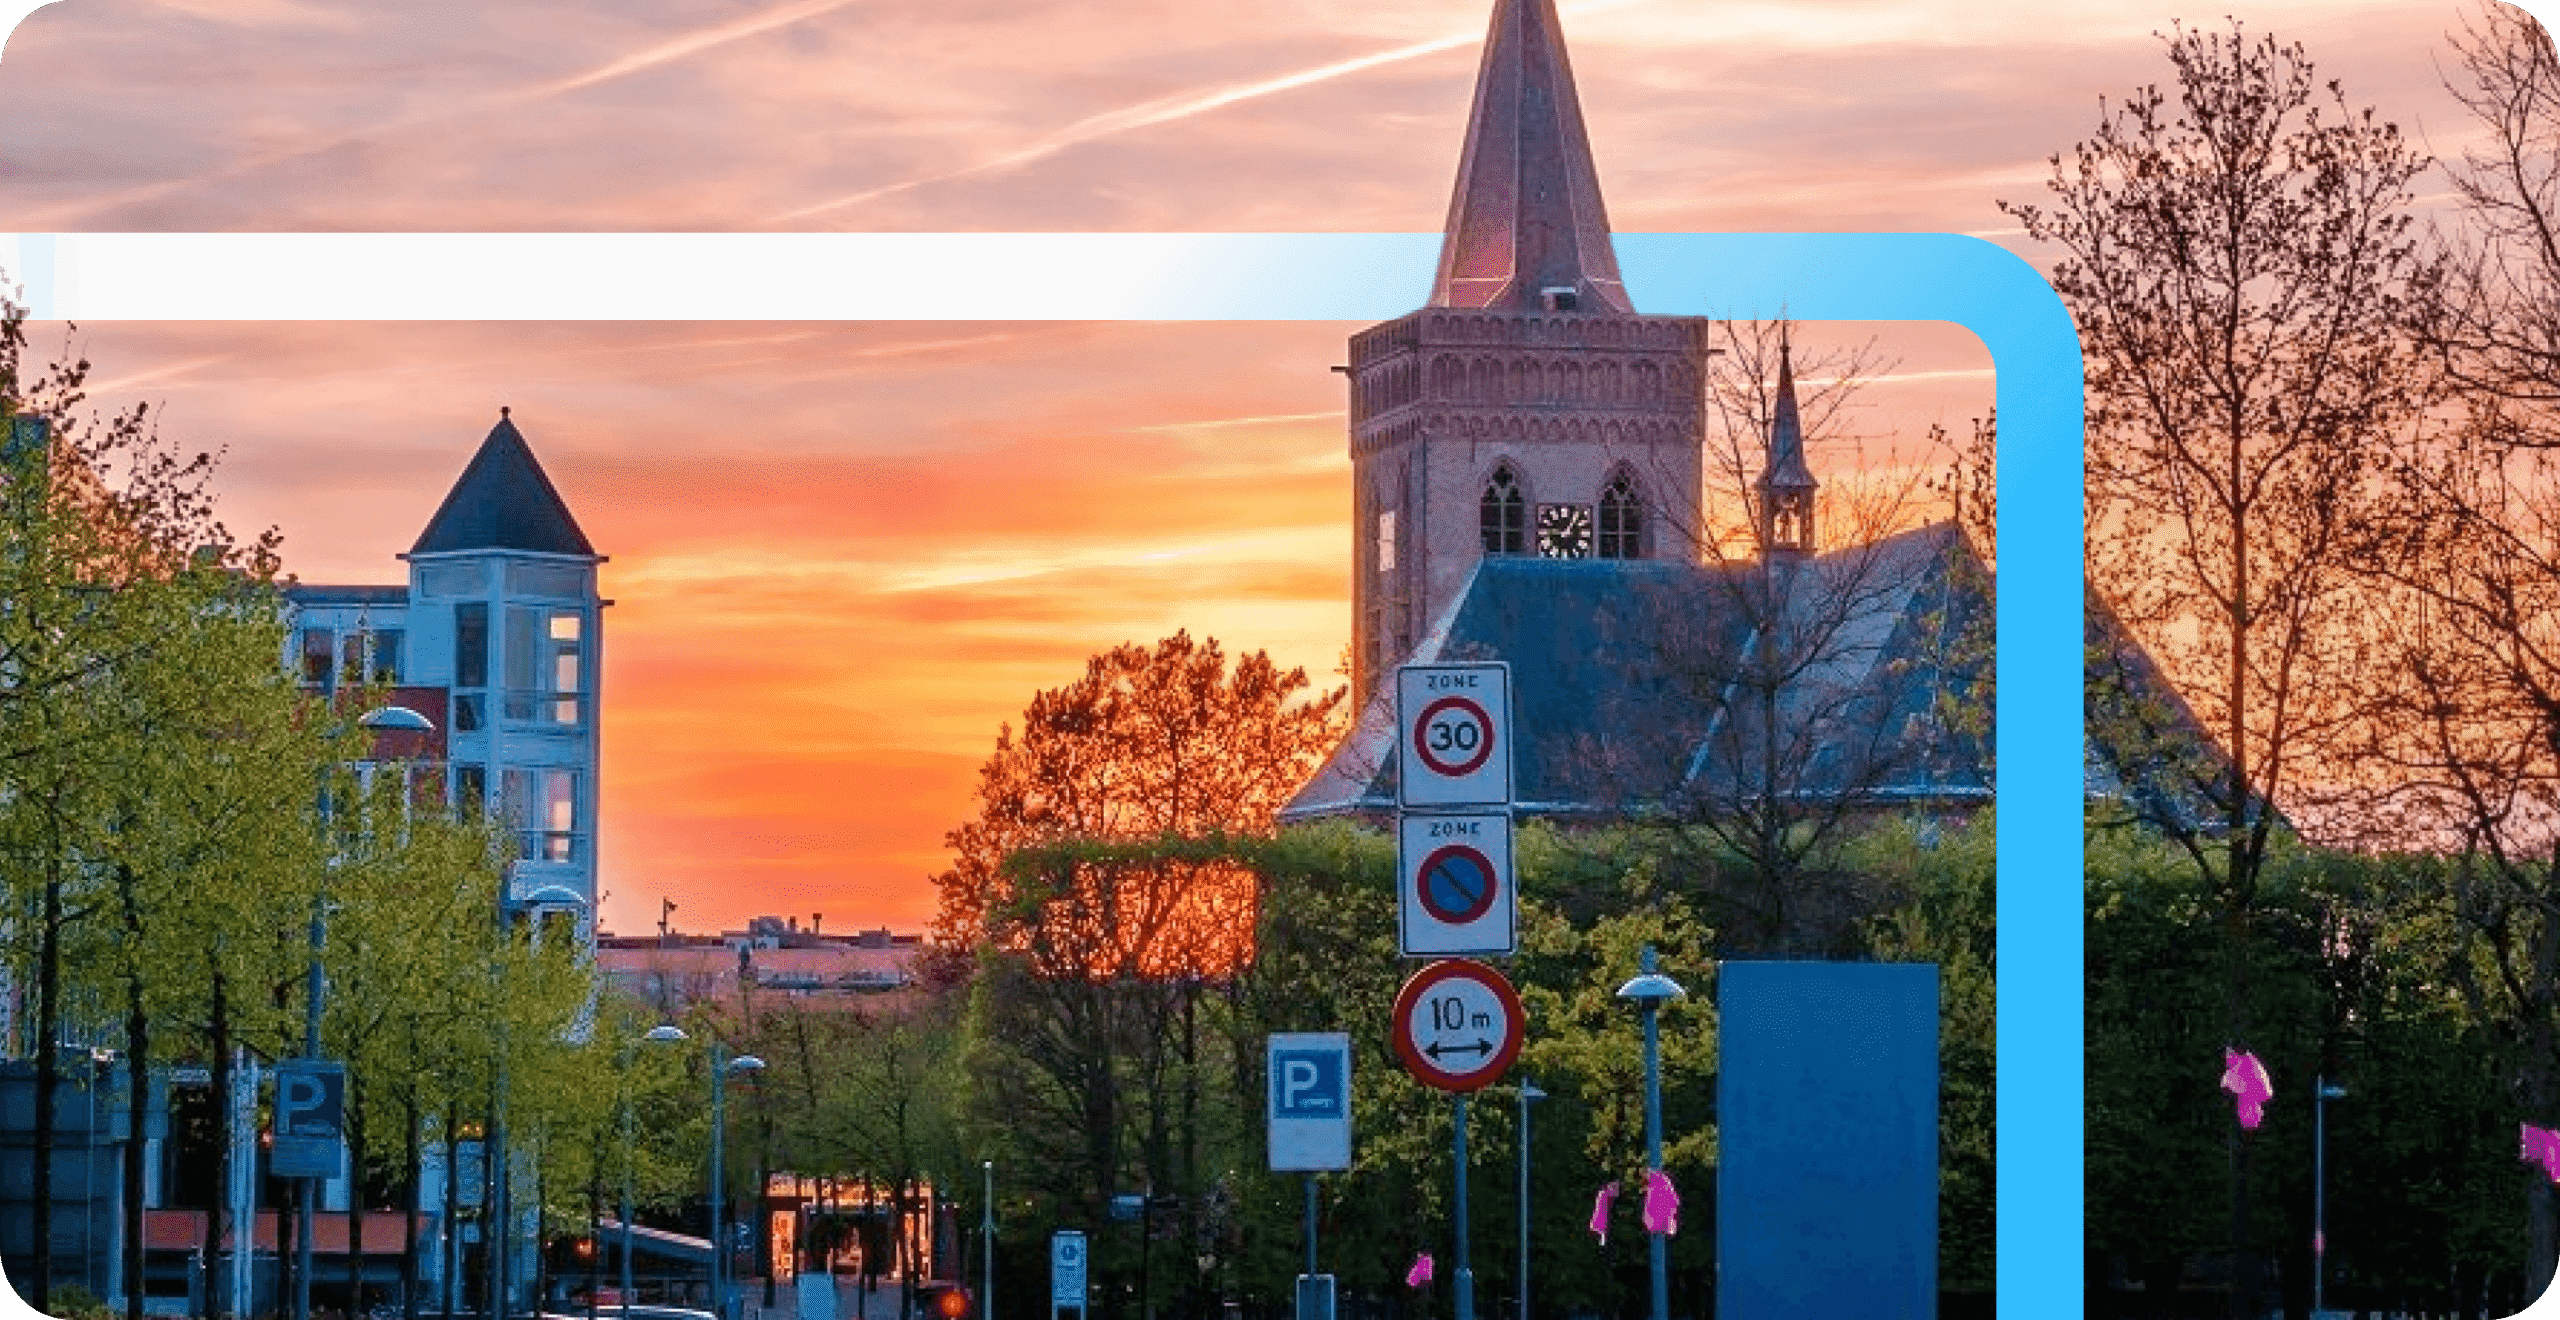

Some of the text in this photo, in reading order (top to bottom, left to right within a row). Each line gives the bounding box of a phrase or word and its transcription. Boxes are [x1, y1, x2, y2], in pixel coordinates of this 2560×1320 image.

[1426, 674, 1479, 690] ZONE
[1431, 721, 1479, 750] 30
[1429, 821, 1481, 837] ZONE
[1431, 997, 1490, 1030] 10 m
[1284, 1060, 1318, 1108] P
[277, 1073, 327, 1135] P
